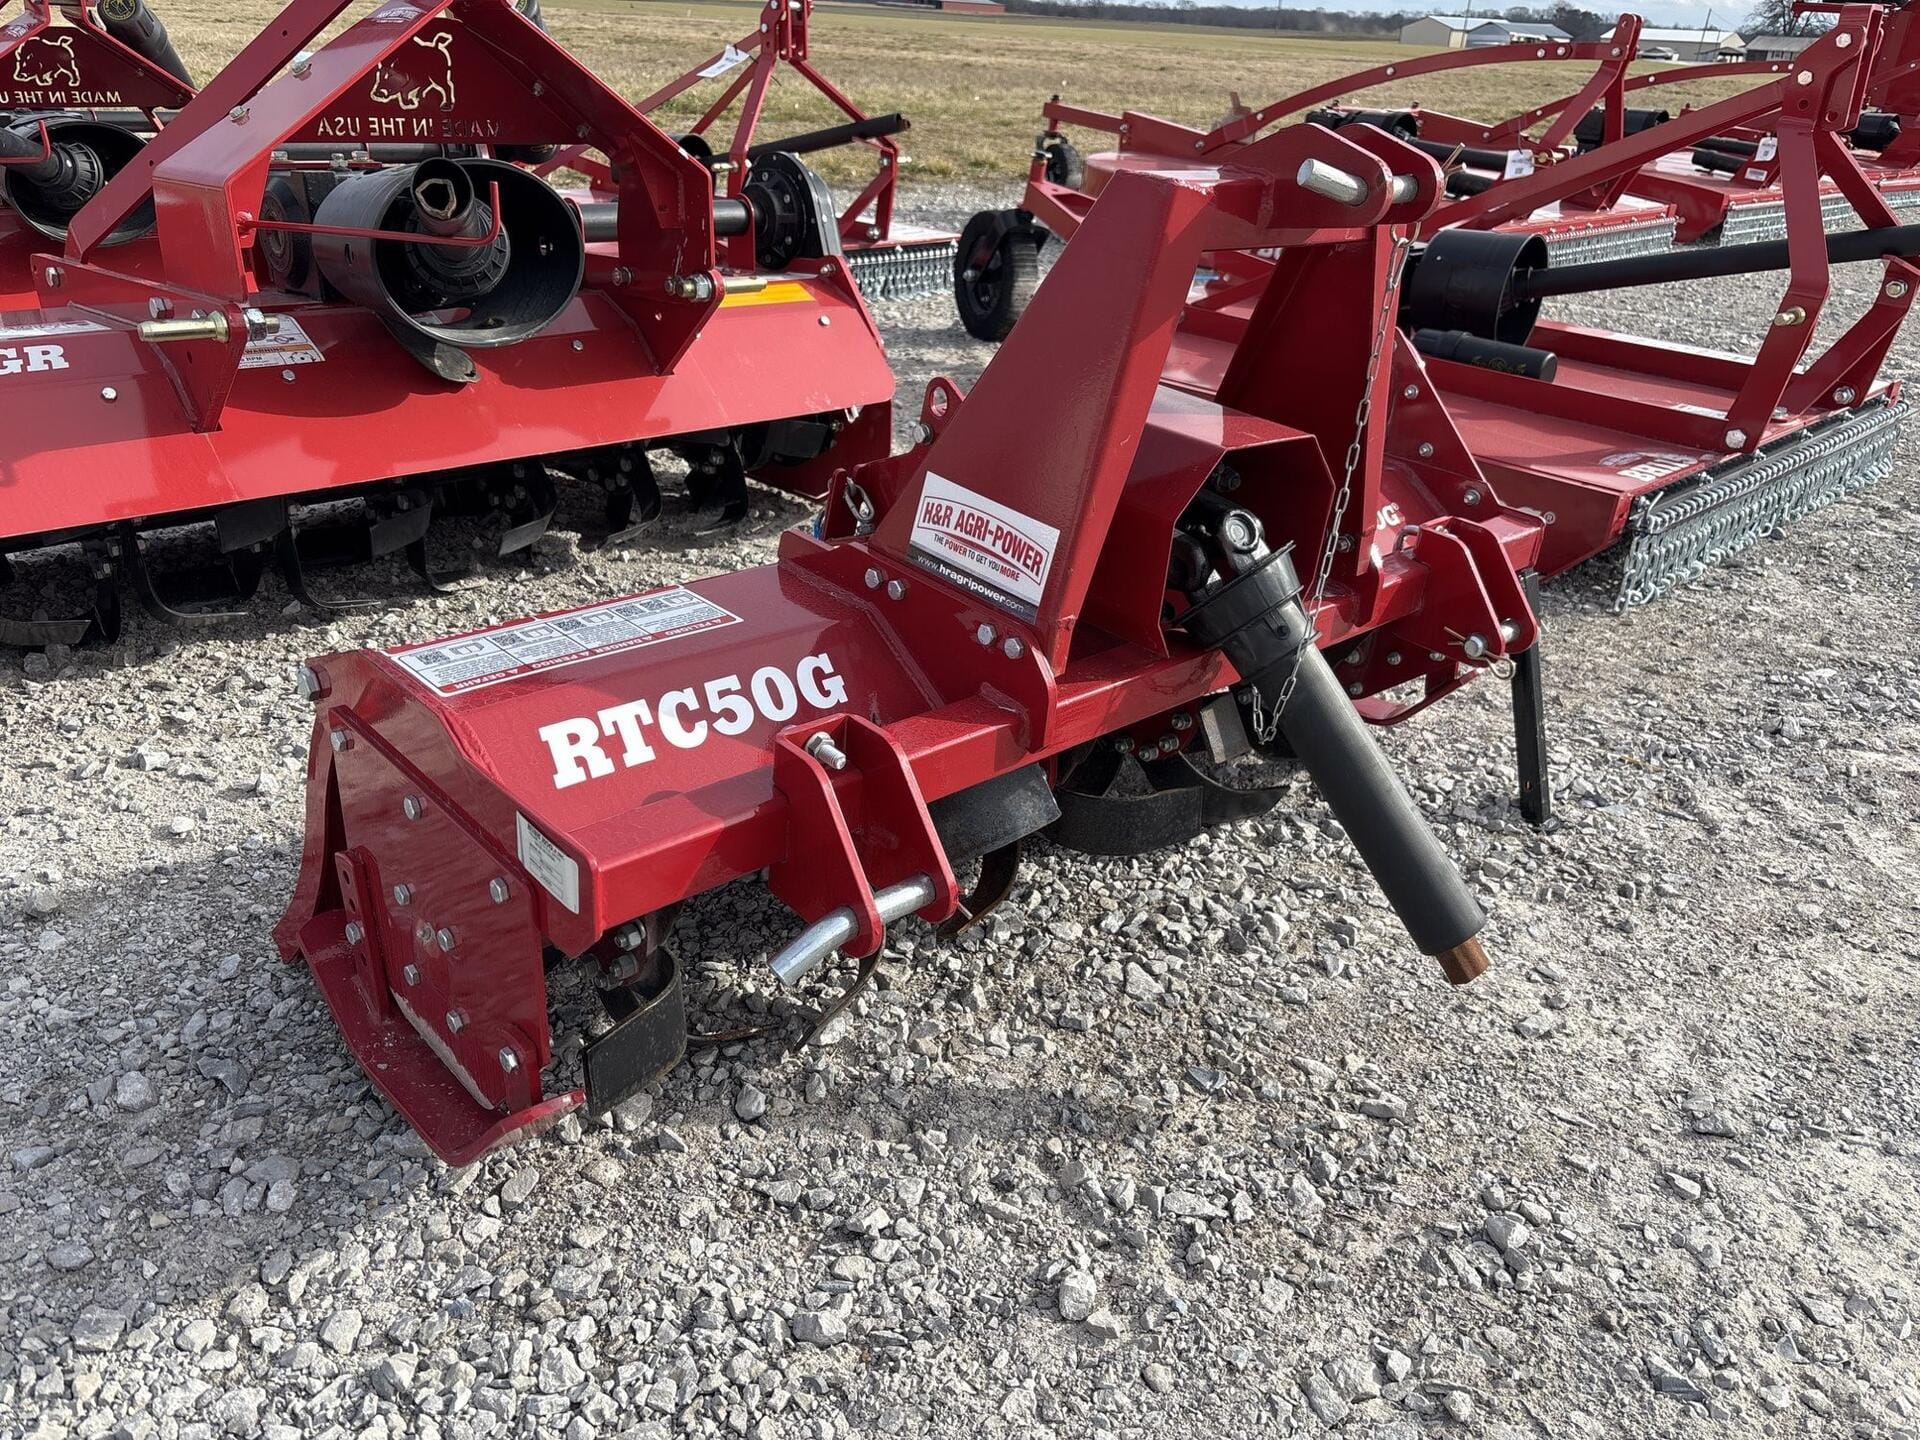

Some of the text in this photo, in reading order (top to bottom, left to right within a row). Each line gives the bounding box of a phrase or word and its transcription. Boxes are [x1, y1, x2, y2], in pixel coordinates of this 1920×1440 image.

[922, 502, 1044, 577] H&R AGRI-POWER
[933, 533, 1021, 582] THE POWER TO GET YOU MORE
[917, 554, 1025, 614] www.hragripower.com
[539, 652, 848, 790] RTC50G
